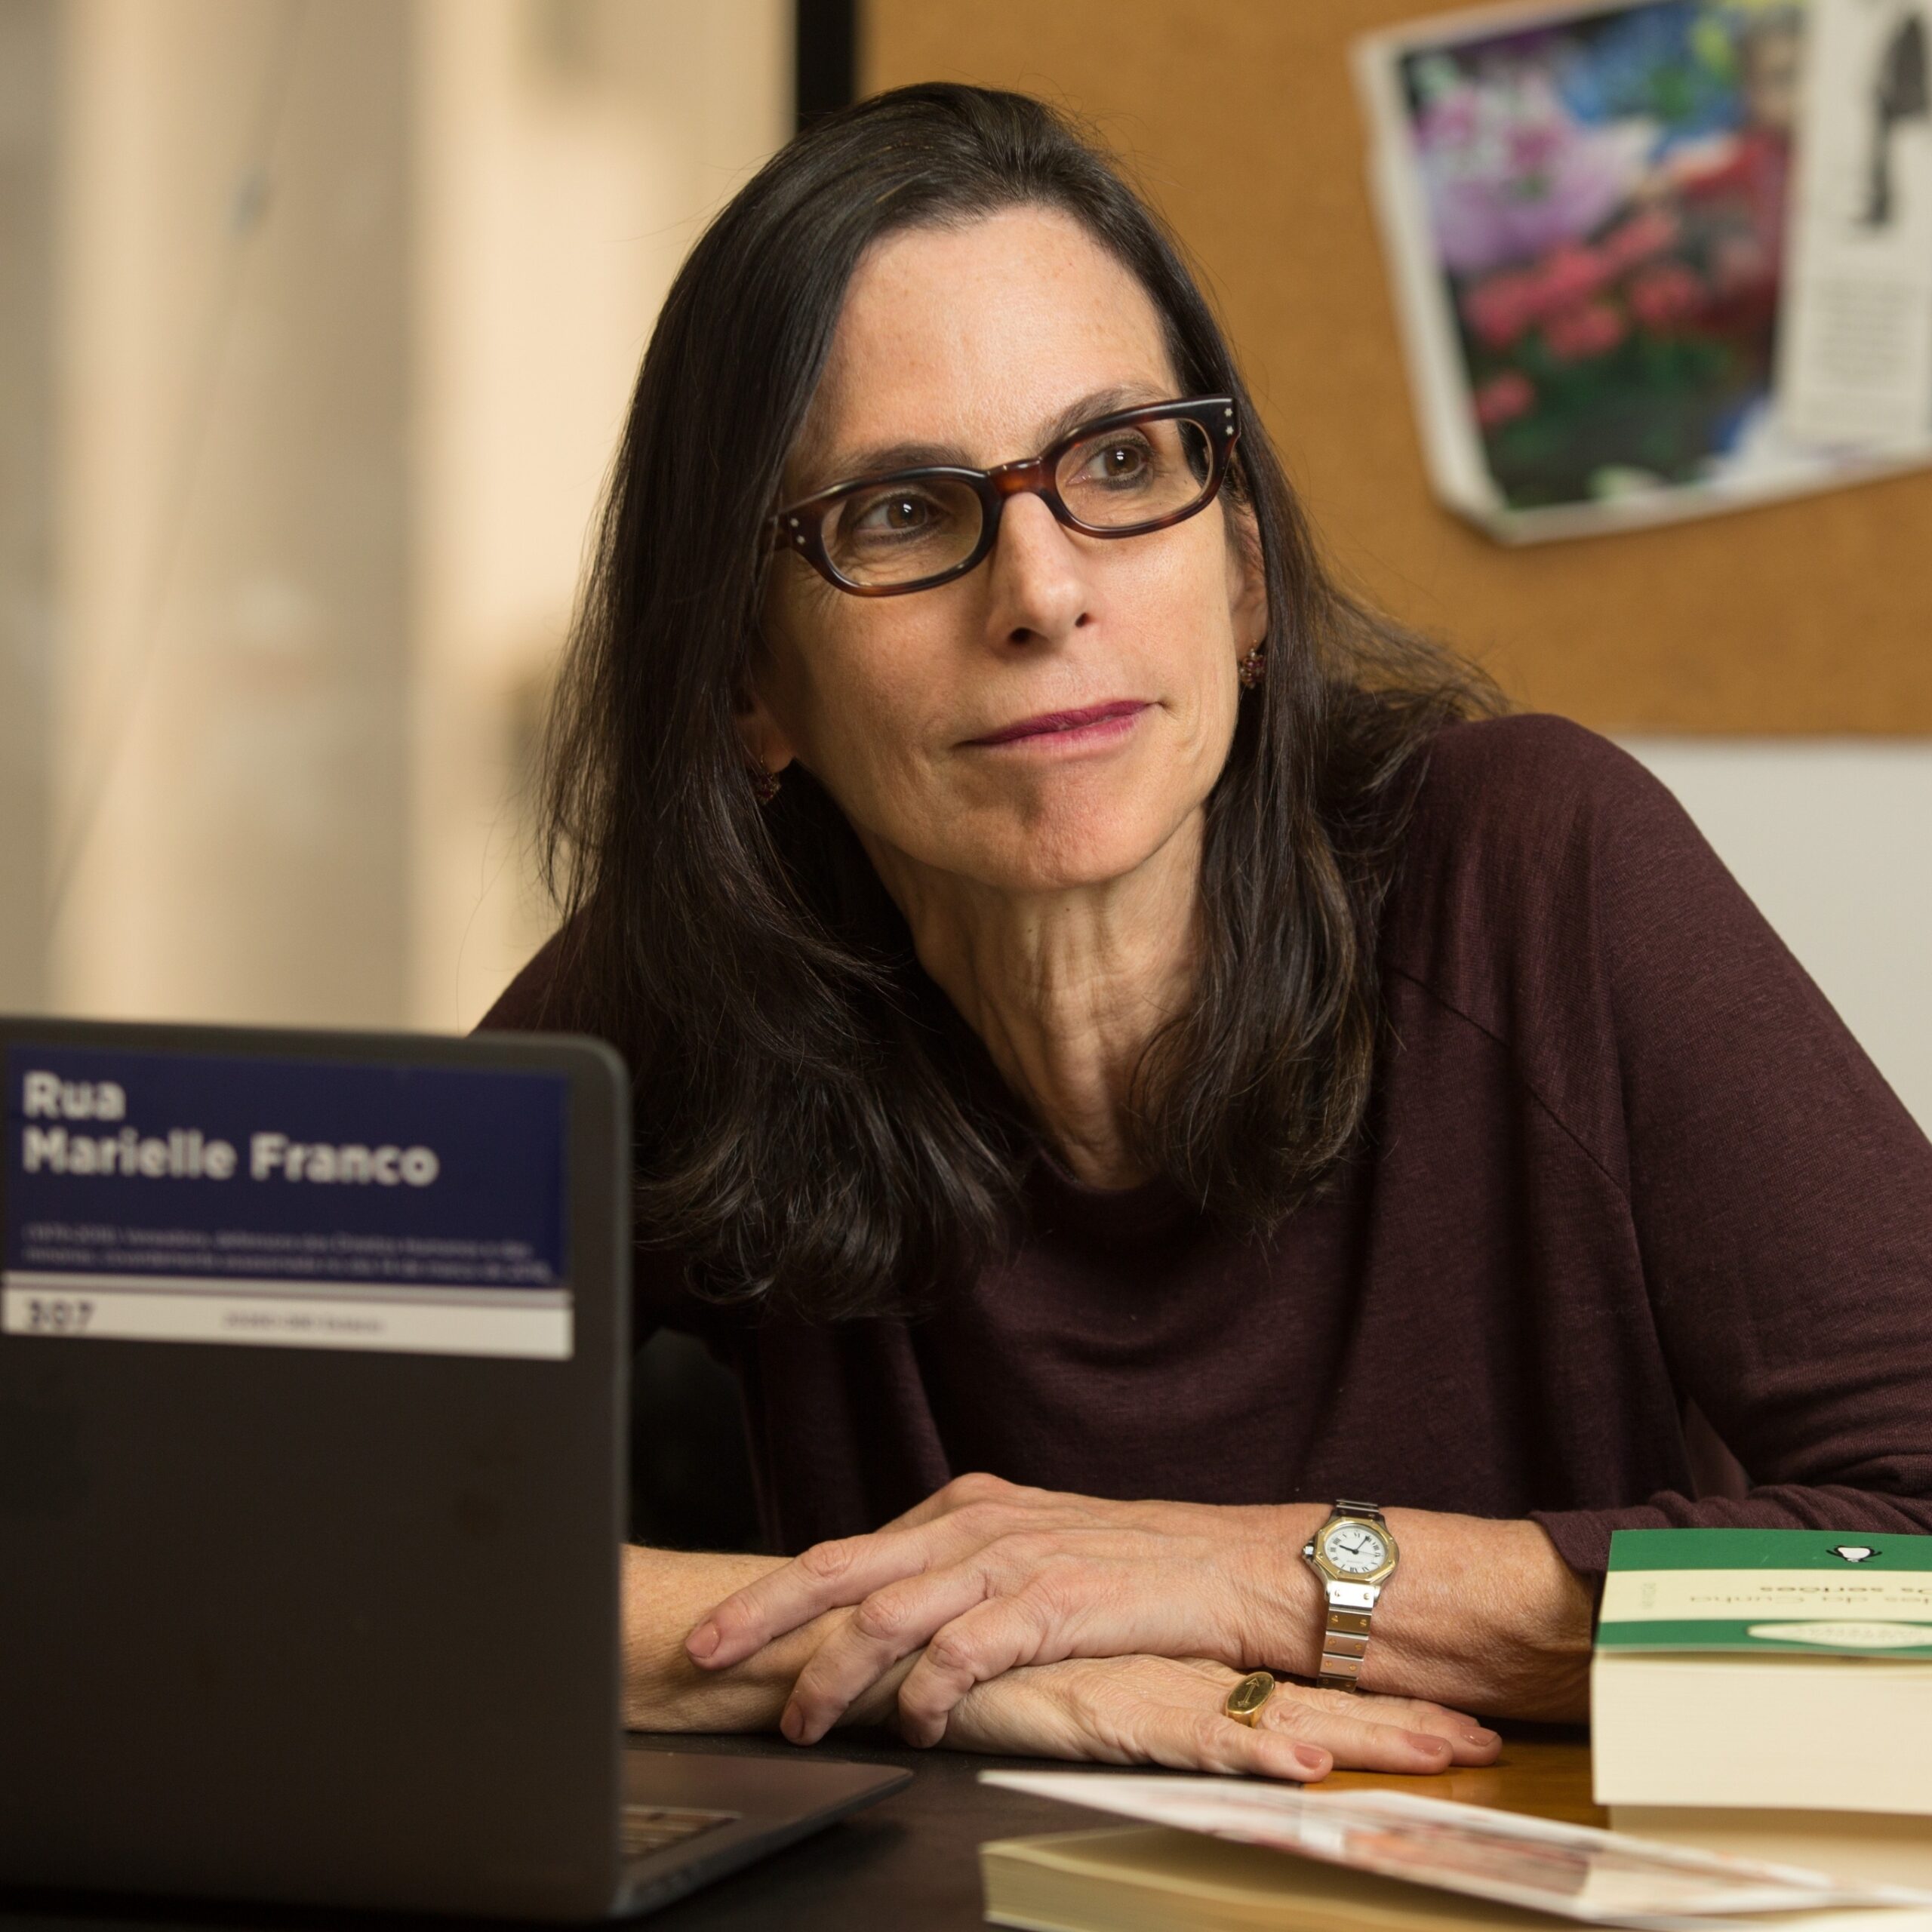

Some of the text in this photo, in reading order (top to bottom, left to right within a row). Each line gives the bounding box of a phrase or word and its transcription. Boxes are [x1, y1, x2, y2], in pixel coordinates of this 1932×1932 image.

[24, 1072, 125, 1119] Rua
[24, 1128, 438, 1185] Marielle Franco
[27, 1298, 94, 1334] 307
